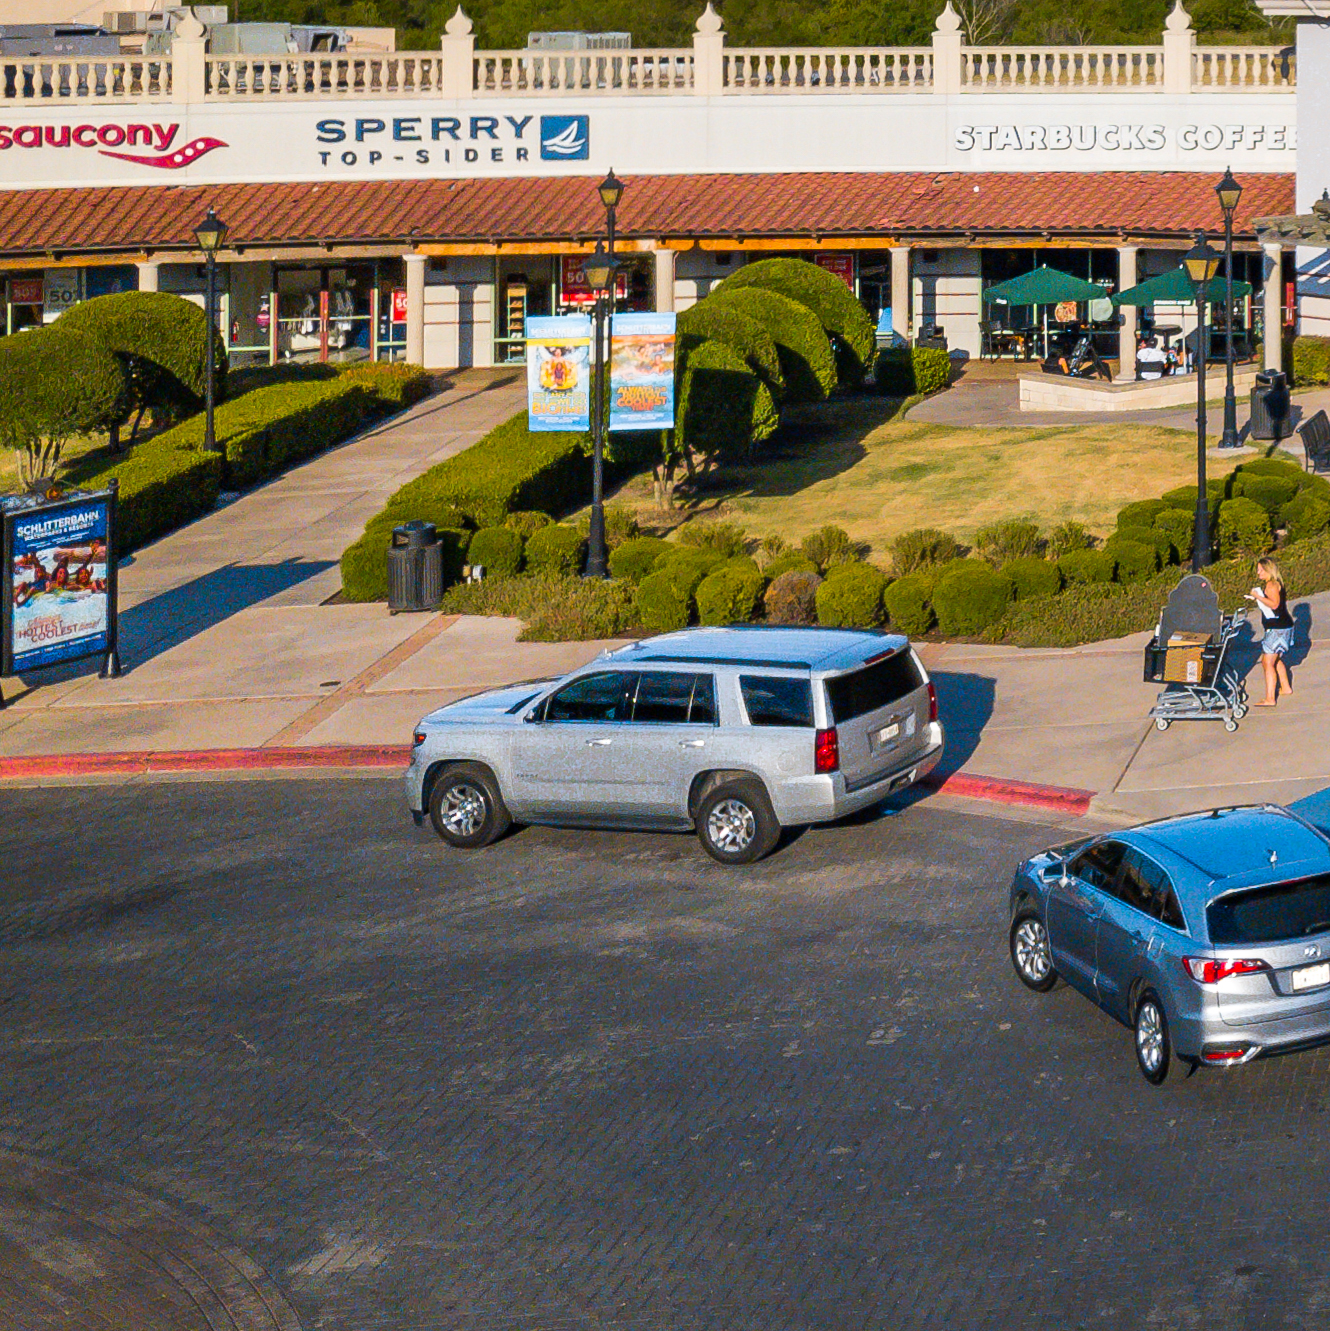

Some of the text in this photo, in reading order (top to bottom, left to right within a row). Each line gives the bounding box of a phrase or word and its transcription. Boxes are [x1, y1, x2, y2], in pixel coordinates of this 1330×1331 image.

[314, 114, 535, 144] SPERRY
[953, 123, 1167, 152] STARBUCKS
[318, 146, 531, 167] TOP-SIDER
[16, 510, 100, 538] SCHLITTERBAHN
